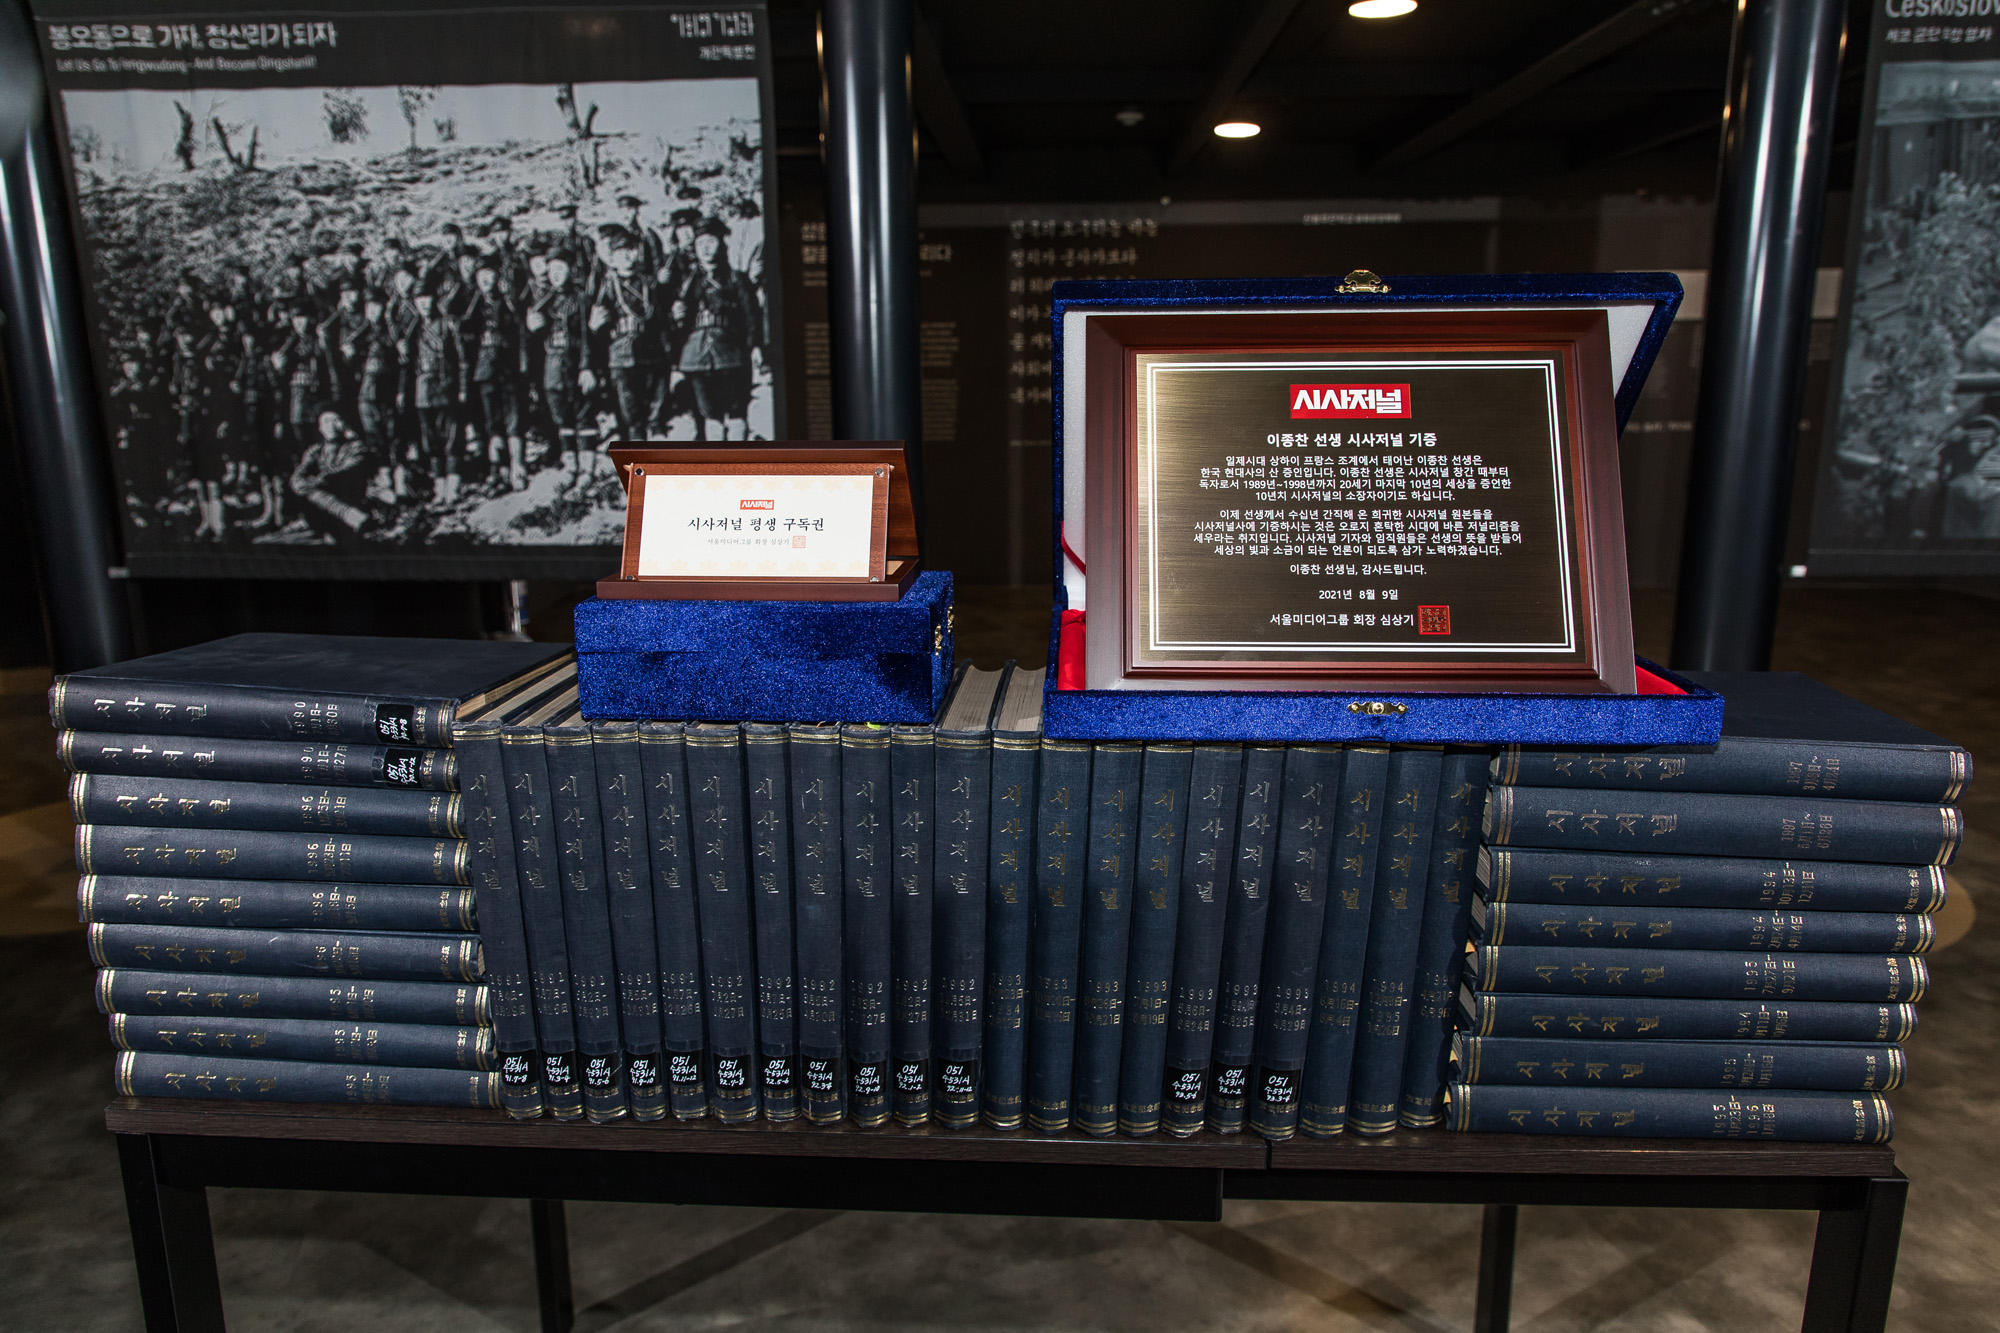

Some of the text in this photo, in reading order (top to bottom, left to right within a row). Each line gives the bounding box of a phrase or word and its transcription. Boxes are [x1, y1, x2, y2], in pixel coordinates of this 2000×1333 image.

[49, 24, 156, 50] 봉오동으로
[206, 22, 290, 50] 청산리가
[293, 21, 337, 48] 되자
[1293, 388, 1403, 414] 시사저널
[1266, 432, 1438, 448] 이종찬 선생 시사저널 기증
[1225, 454, 1483, 467] 일제시대 상하이 프랑스 조계에서 태어난 이종찬 선생은
[1200, 466, 1509, 479] 한국 현대사의 산 증인입니다. 이종찬 선생은 시사저널 창간 때부터
[1198, 478, 1512, 490] 독자로서 1989년~1998년까지 20세기 마지막 10년의 세상을 증언한
[1255, 490, 1456, 502] 10년치 시사저널의 소장자이기도 하십니다.
[741, 500, 774, 510] 시사저널
[1219, 508, 1493, 521] 이제 선생께서 수십년 간직해 온 희귀한 시사저널 원본들을
[687, 517, 825, 532] 시사저널 평생 구독권
[1193, 520, 1520, 533] 시사저널사에 기증하시는 것은 오로지 혼탁한 시대에 바른 저널리즘을
[707, 537, 752, 546] 서울미디어그룹
[771, 537, 790, 546] 심상기
[1193, 530, 1522, 544] 세우라는 취지입니다. 시사저널 기자와 임직원들은 선생의 뜻을 받들어
[1213, 544, 1503, 556] 세상의 빛과 소금이 되는 언론이 되도록 삼가 노력하겠습니다.
[1289, 563, 1427, 576] 이종찬 선생님, 감사드립니다.
[1318, 588, 1399, 601] 2021년 8월 9일
[1269, 613, 1350, 626] 서울미디어그룹
[1353, 613, 1376, 626] 회장
[1380, 613, 1414, 627] 심상기
[1760, 871, 1776, 902] 1994
[1744, 961, 1758, 991] 1995
[1179, 988, 1213, 1000] 1993
[546, 1056, 562, 1066] 051
[633, 1060, 649, 1070] 051
[672, 1055, 691, 1066] 051
[809, 1061, 827, 1071] 051
[902, 1064, 919, 1075] 051
[1181, 1073, 1201, 1083] 051
[1268, 1075, 1289, 1087] 051
